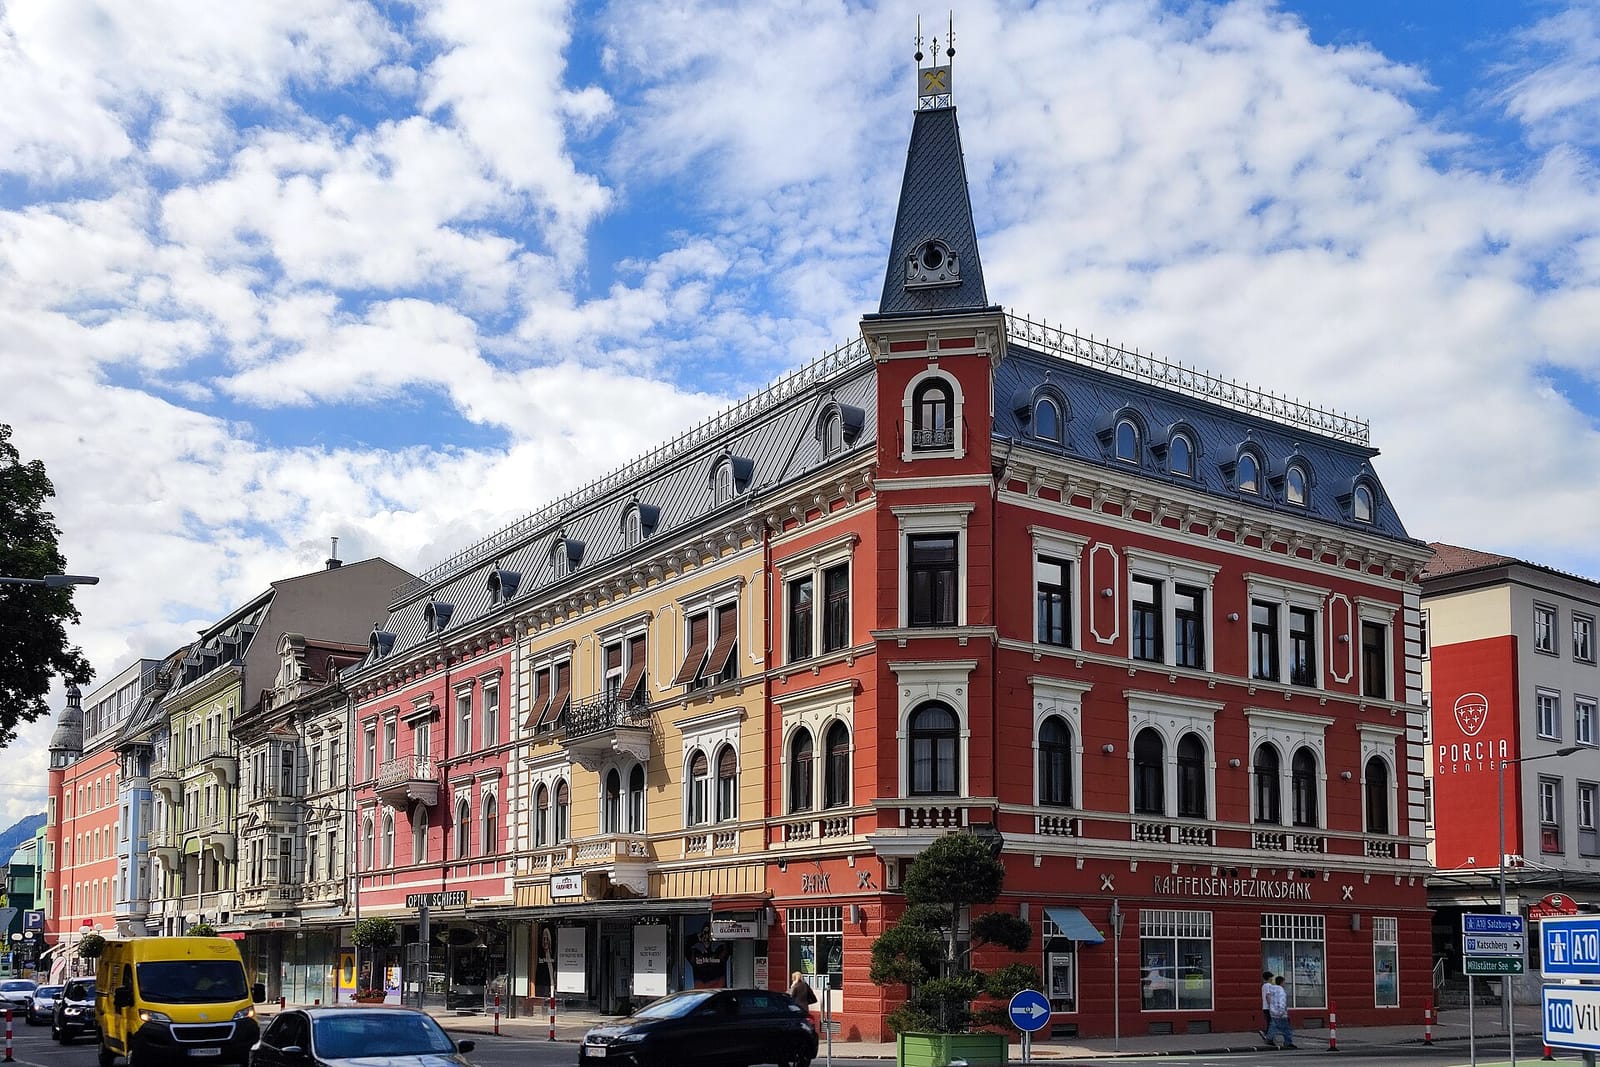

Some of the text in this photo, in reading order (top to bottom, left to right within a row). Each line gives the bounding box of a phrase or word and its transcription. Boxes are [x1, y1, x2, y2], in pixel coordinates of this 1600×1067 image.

[1439, 739, 1507, 763] PORCIA
[1154, 875, 1312, 900] RAIFFEISEN-BEZIRKSBANK
[408, 891, 465, 907] OPTIK SCHIFFER
[28, 913, 41, 927] P
[1487, 919, 1512, 931] Salzburg
[1477, 940, 1508, 951] Katschberg
[1574, 933, 1597, 961] A10
[1498, 961, 1509, 971] See
[1549, 1002, 1573, 1030] 100
